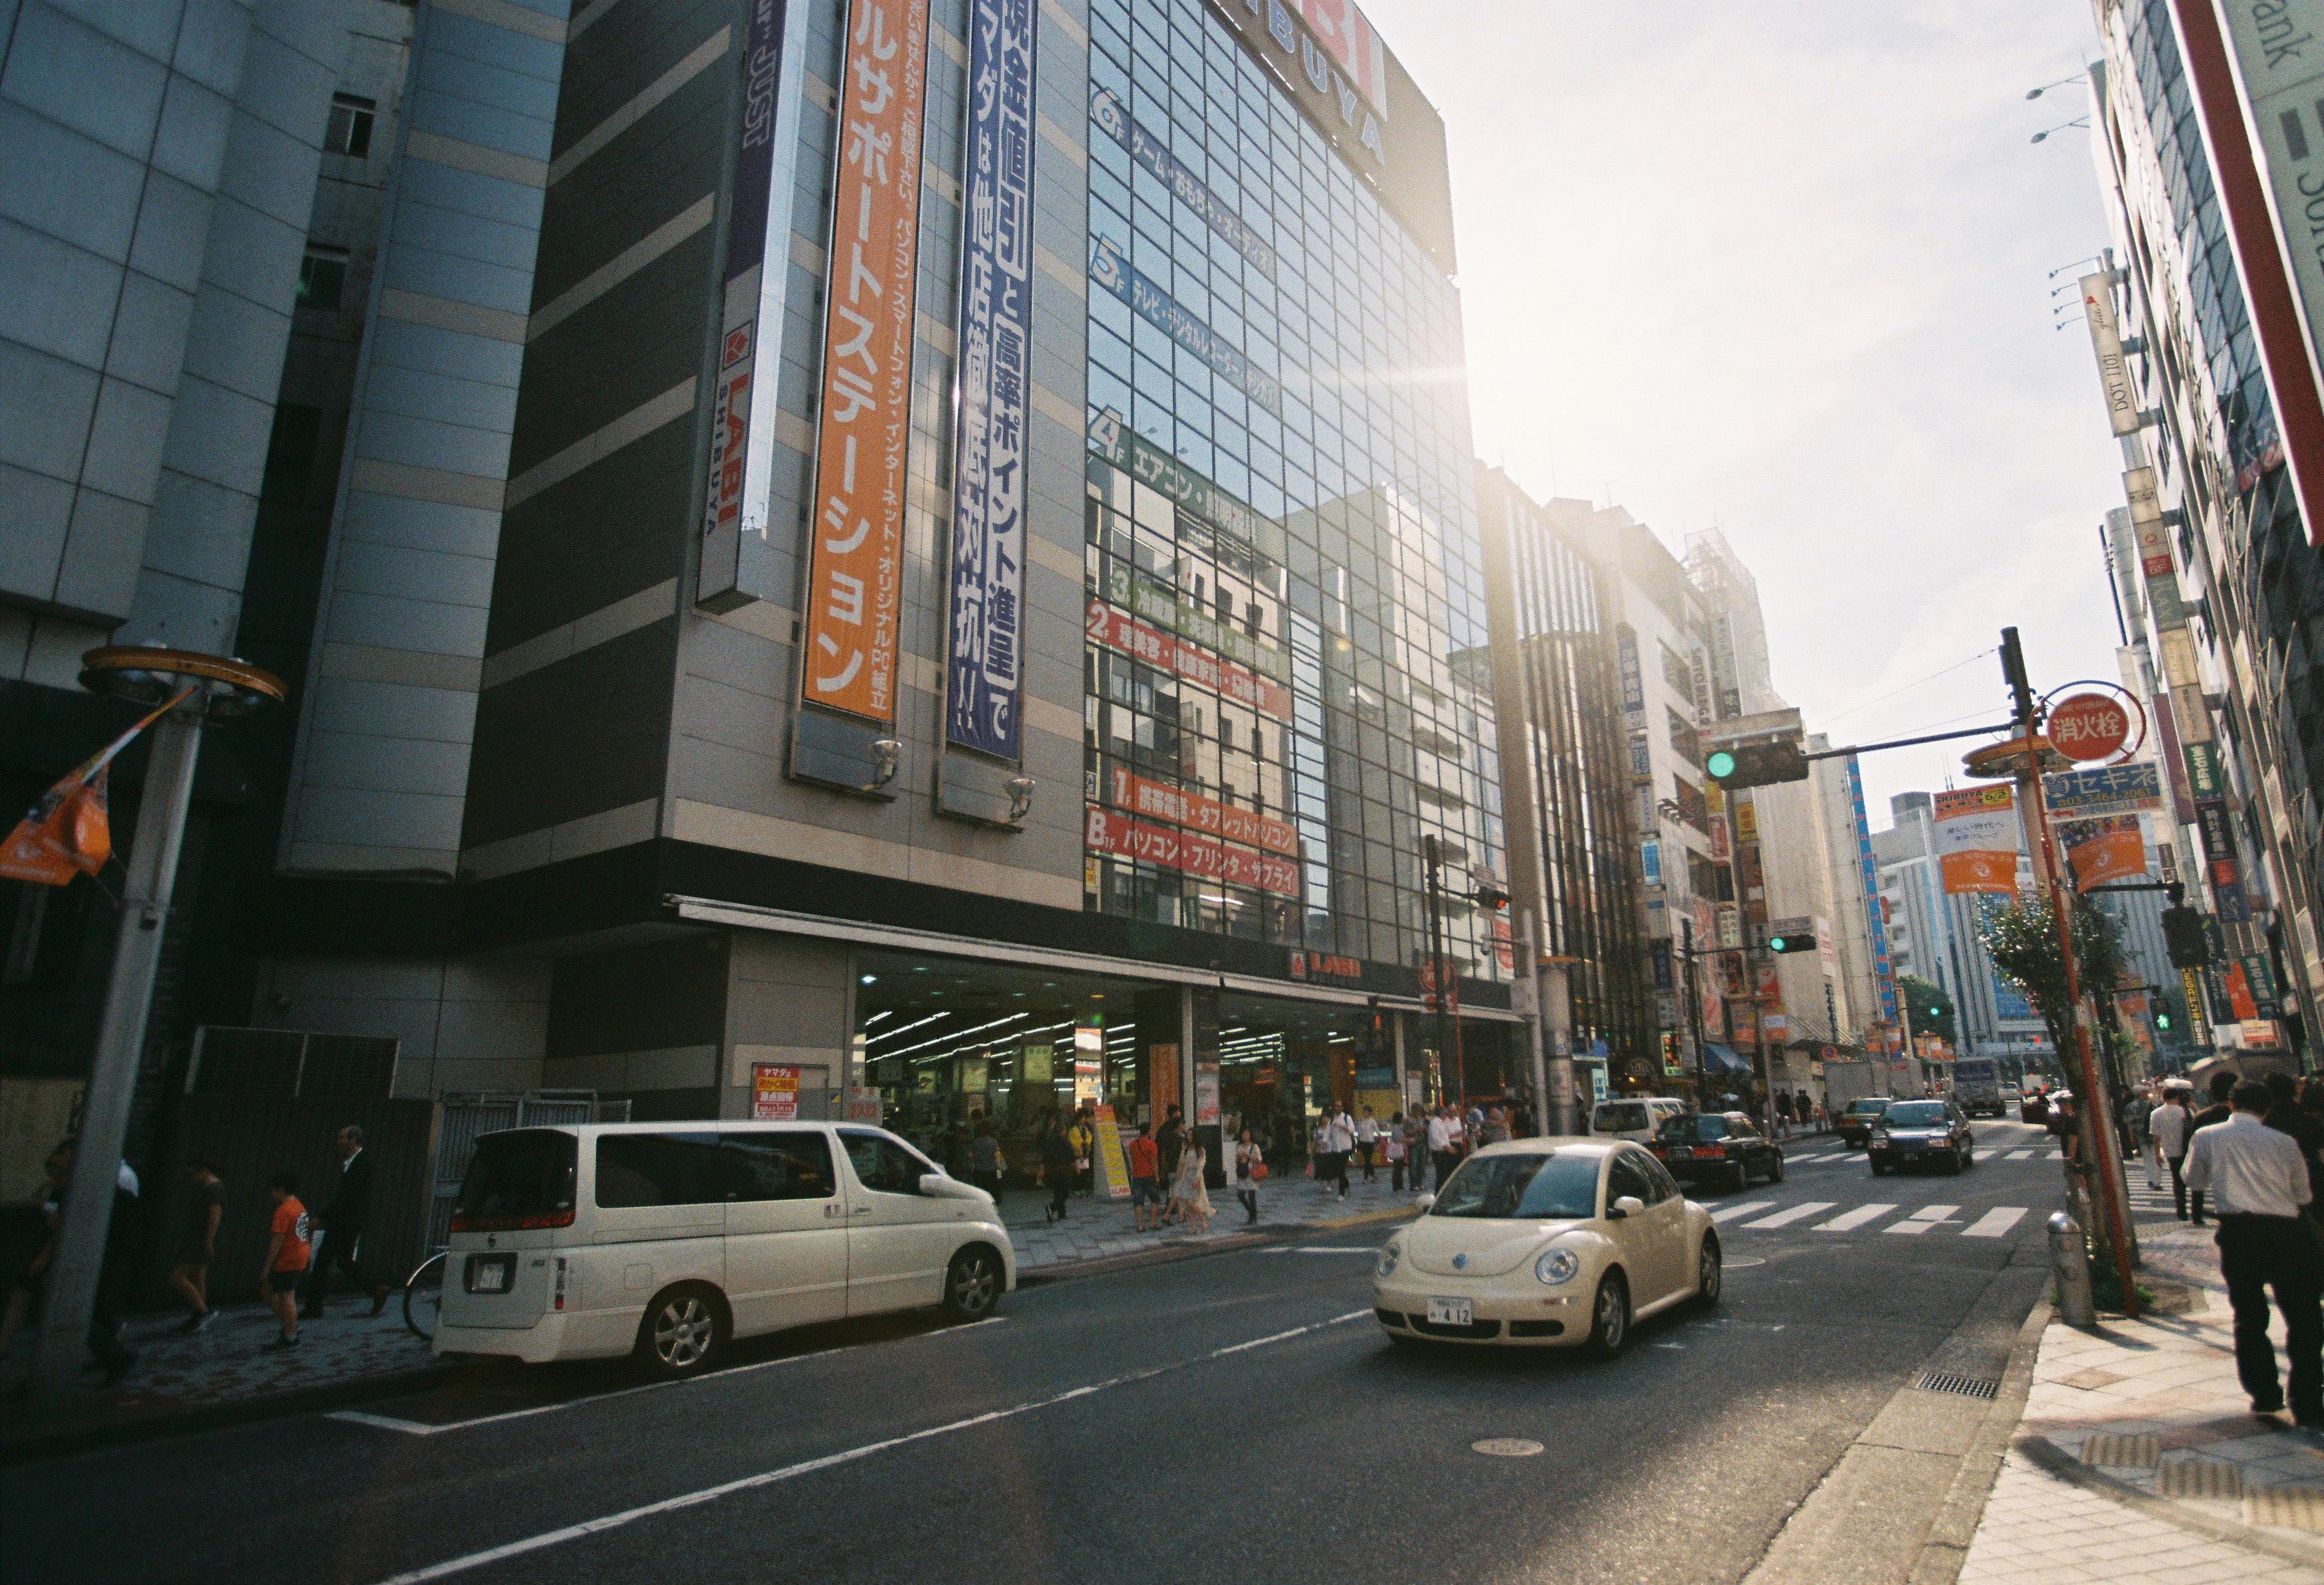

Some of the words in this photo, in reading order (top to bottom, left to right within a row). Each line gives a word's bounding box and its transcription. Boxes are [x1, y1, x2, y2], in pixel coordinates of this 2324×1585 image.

[743, 45, 778, 149] JUST
[1247, 0, 1385, 166] BUYA
[956, 0, 998, 729] マダは他店徹底対抗!!
[2109, 382, 2129, 412] DOT
[706, 383, 728, 536] SHIBUYA
[718, 372, 751, 523] LABI
[2053, 710, 2123, 743] 消火栓
[1935, 790, 1983, 804] SHIBUYA
[2072, 764, 2157, 794] セキネ
